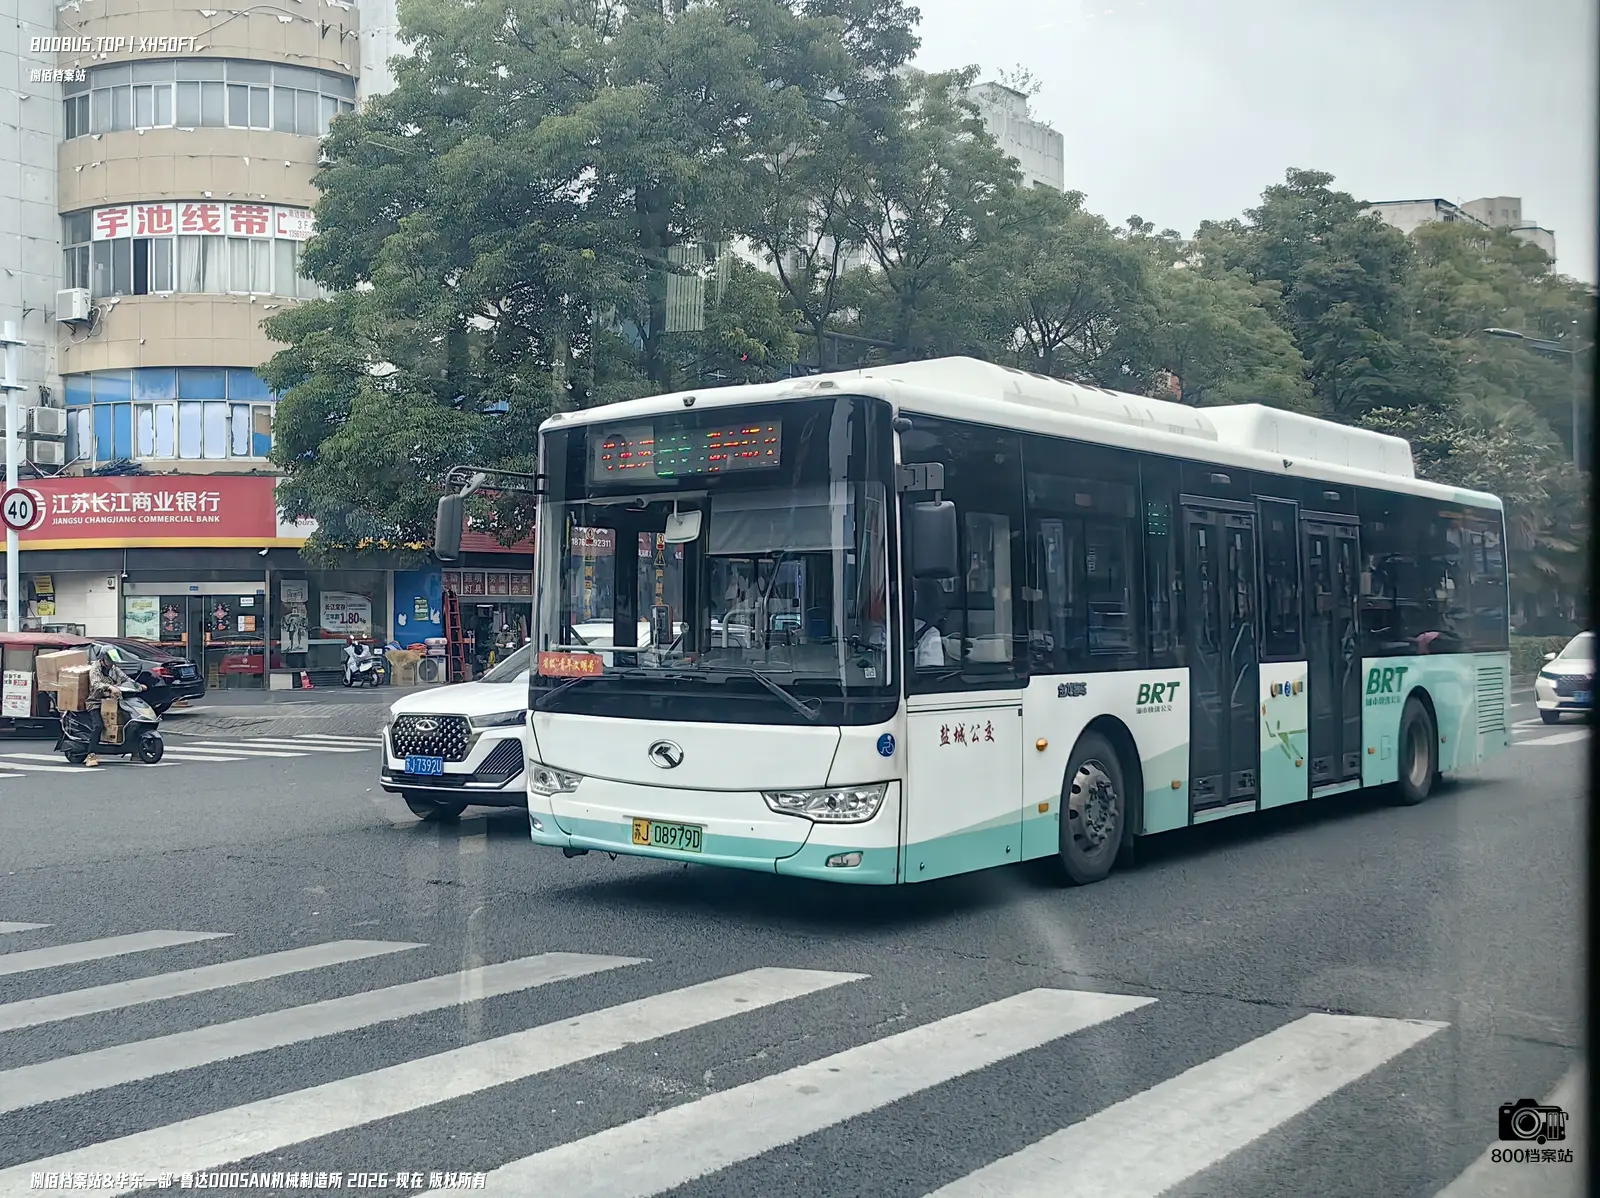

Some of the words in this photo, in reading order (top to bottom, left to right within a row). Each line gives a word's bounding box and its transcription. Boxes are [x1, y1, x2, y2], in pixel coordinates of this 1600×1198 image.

[97, 204, 270, 238] 宇池线带
[8, 500, 28, 520] 40
[52, 491, 221, 514] 江苏长江商业银行
[52, 516, 83, 525] JIANGSU
[84, 515, 137, 525] CHANGJIANG
[138, 515, 194, 524] COMMERCIAL
[196, 515, 221, 524] BANK
[1366, 666, 1409, 694] BRT
[1136, 681, 1180, 706] BRT
[939, 720, 995, 747] 盐城公交
